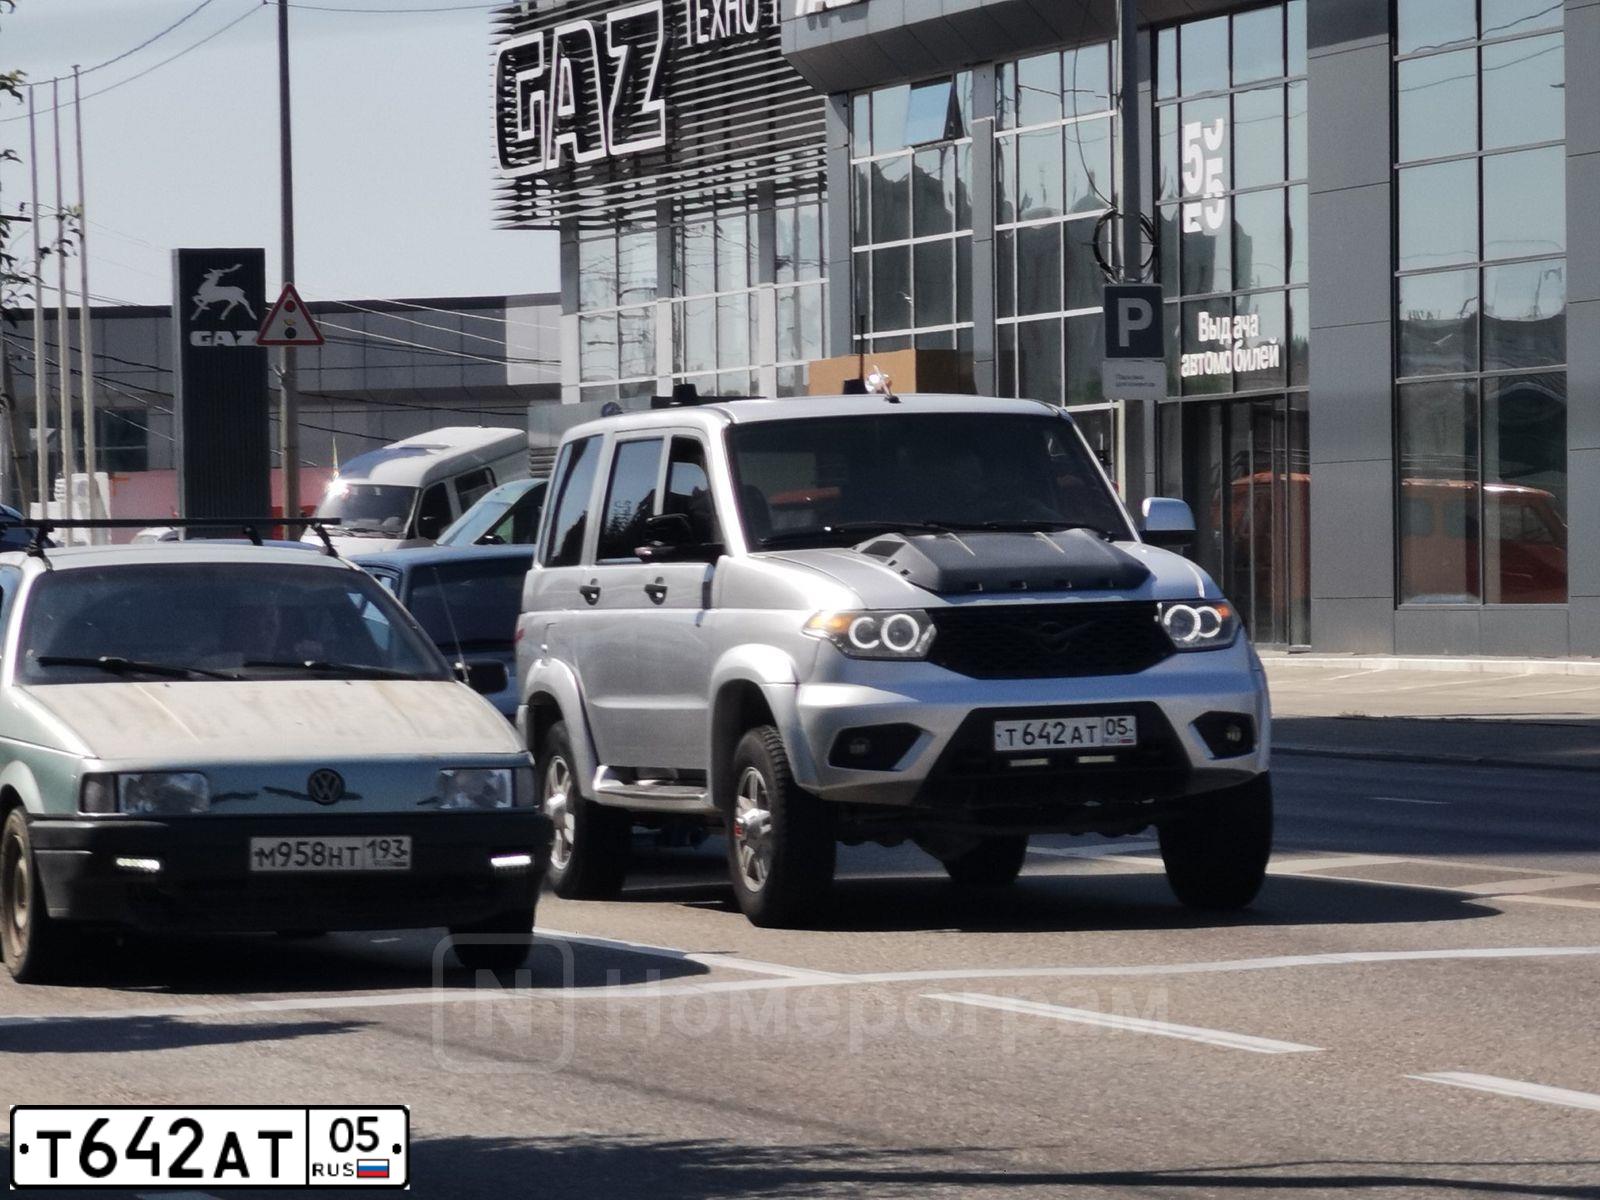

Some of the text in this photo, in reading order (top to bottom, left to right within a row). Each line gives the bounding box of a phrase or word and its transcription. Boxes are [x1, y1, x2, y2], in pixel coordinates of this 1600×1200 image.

[498, 0, 665, 176] GAZ
[190, 330, 258, 347] GAZ
[1118, 297, 1153, 347] P
[1198, 311, 1259, 345] Выдача
[1180, 336, 1280, 378] автомобилей
[1004, 718, 1128, 747] Т642АТ 05
[366, 838, 406, 859] 193
